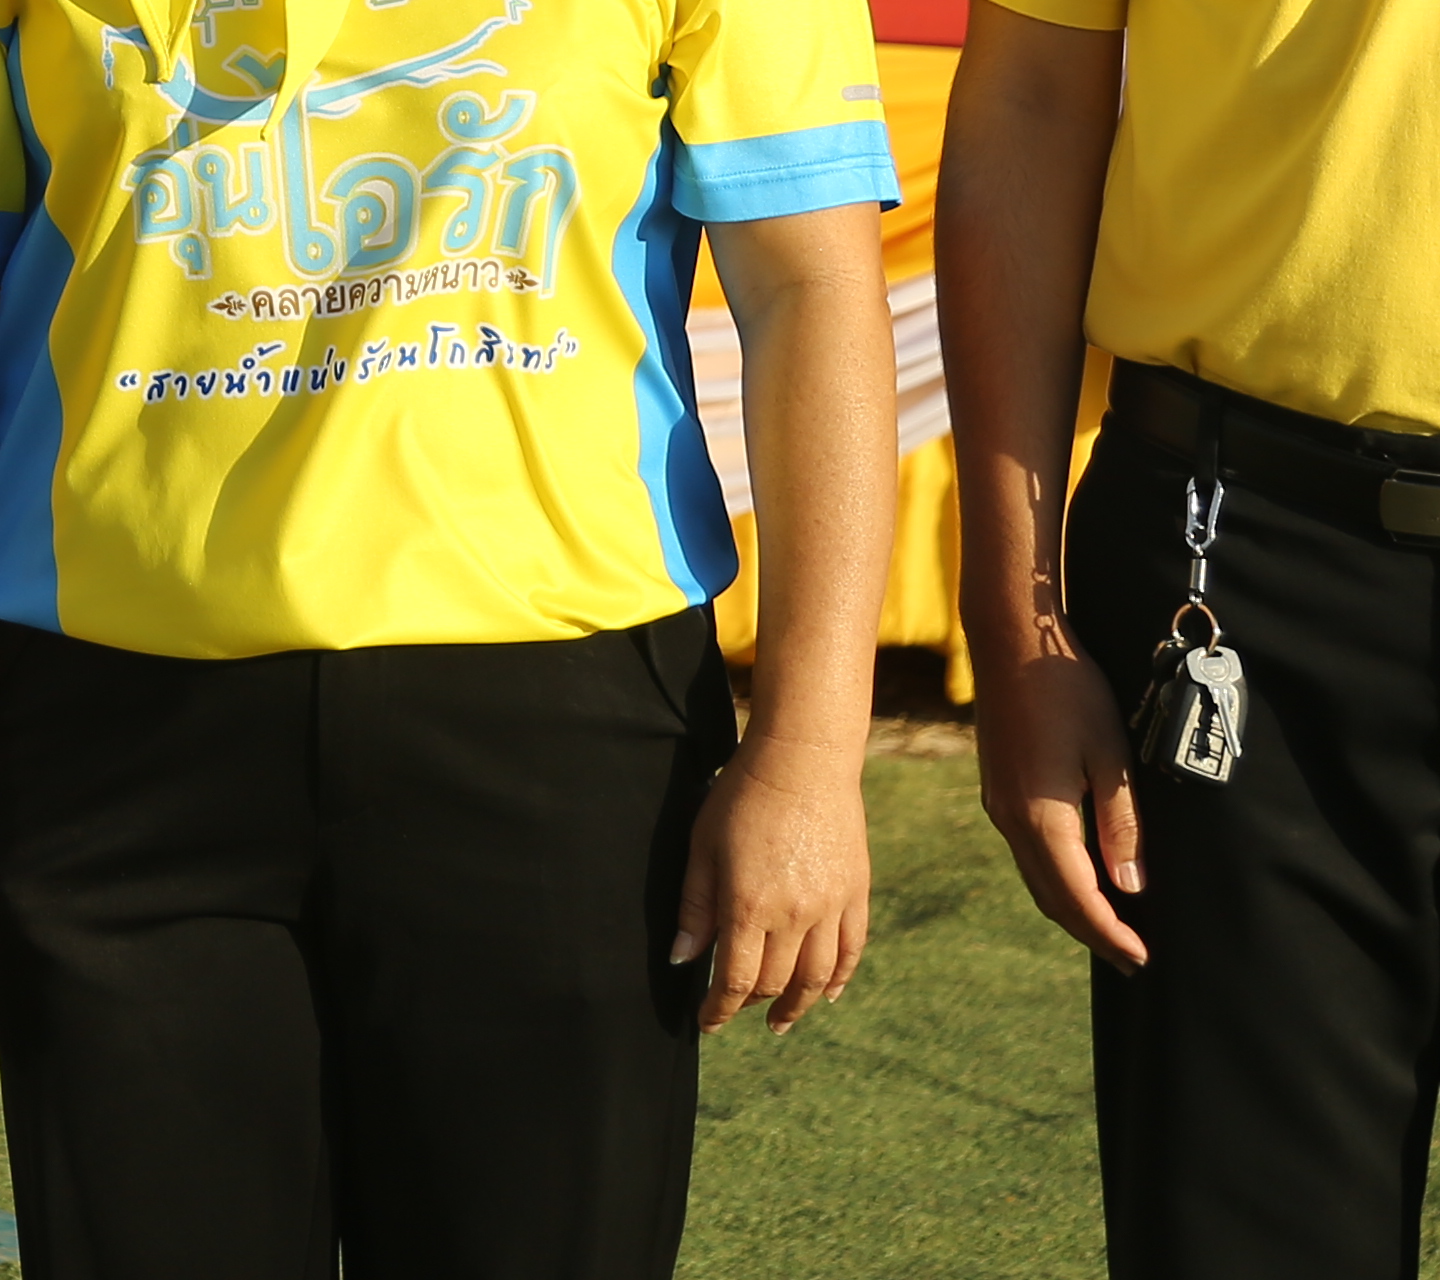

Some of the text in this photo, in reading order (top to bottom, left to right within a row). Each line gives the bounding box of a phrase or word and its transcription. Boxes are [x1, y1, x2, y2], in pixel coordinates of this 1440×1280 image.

[251, 258, 503, 322] คลายความหนาว
